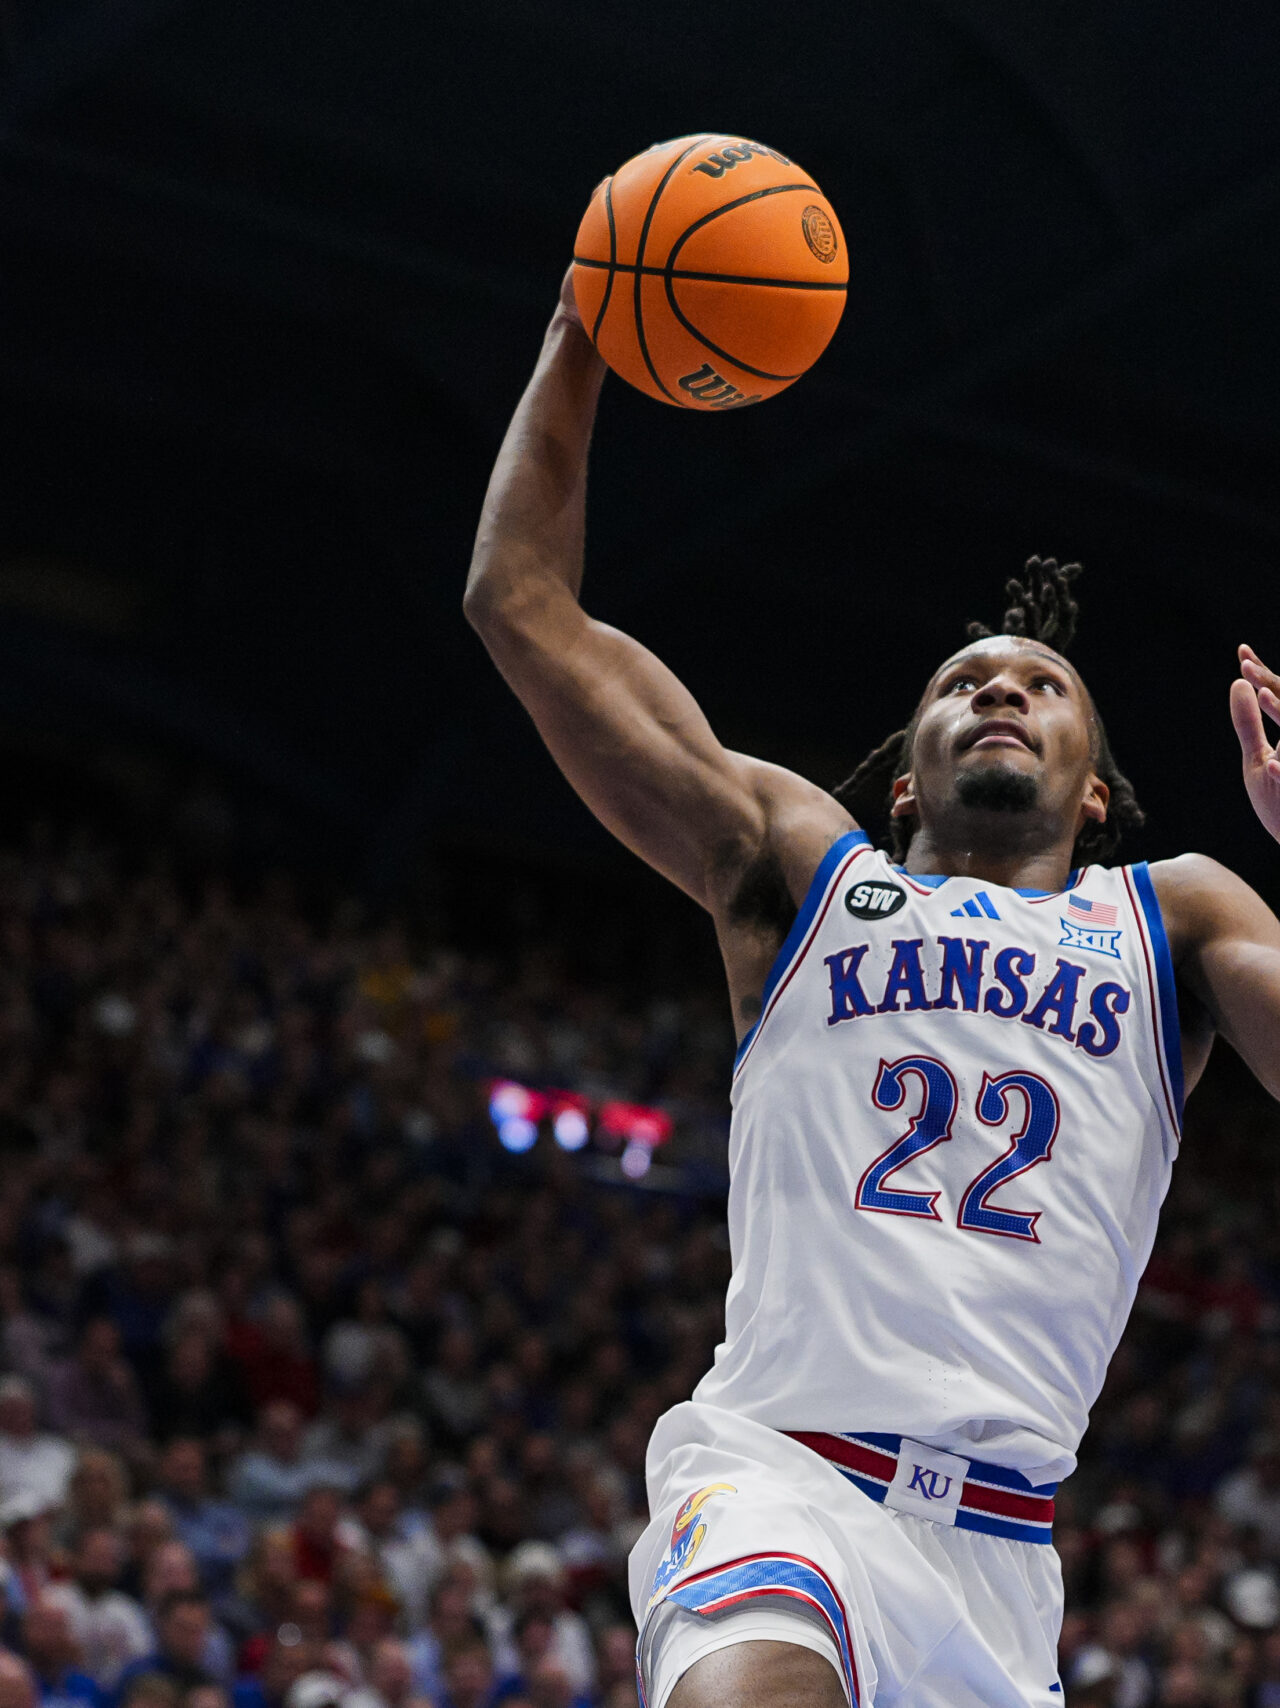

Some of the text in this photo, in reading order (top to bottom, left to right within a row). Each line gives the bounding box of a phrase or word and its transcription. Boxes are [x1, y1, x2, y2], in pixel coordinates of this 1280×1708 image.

[678, 362, 763, 410] Wil
[850, 885, 900, 911] SW
[823, 935, 1131, 1057] KANSAS
[855, 1054, 1061, 1243] 22
[906, 1463, 953, 1500] KU
